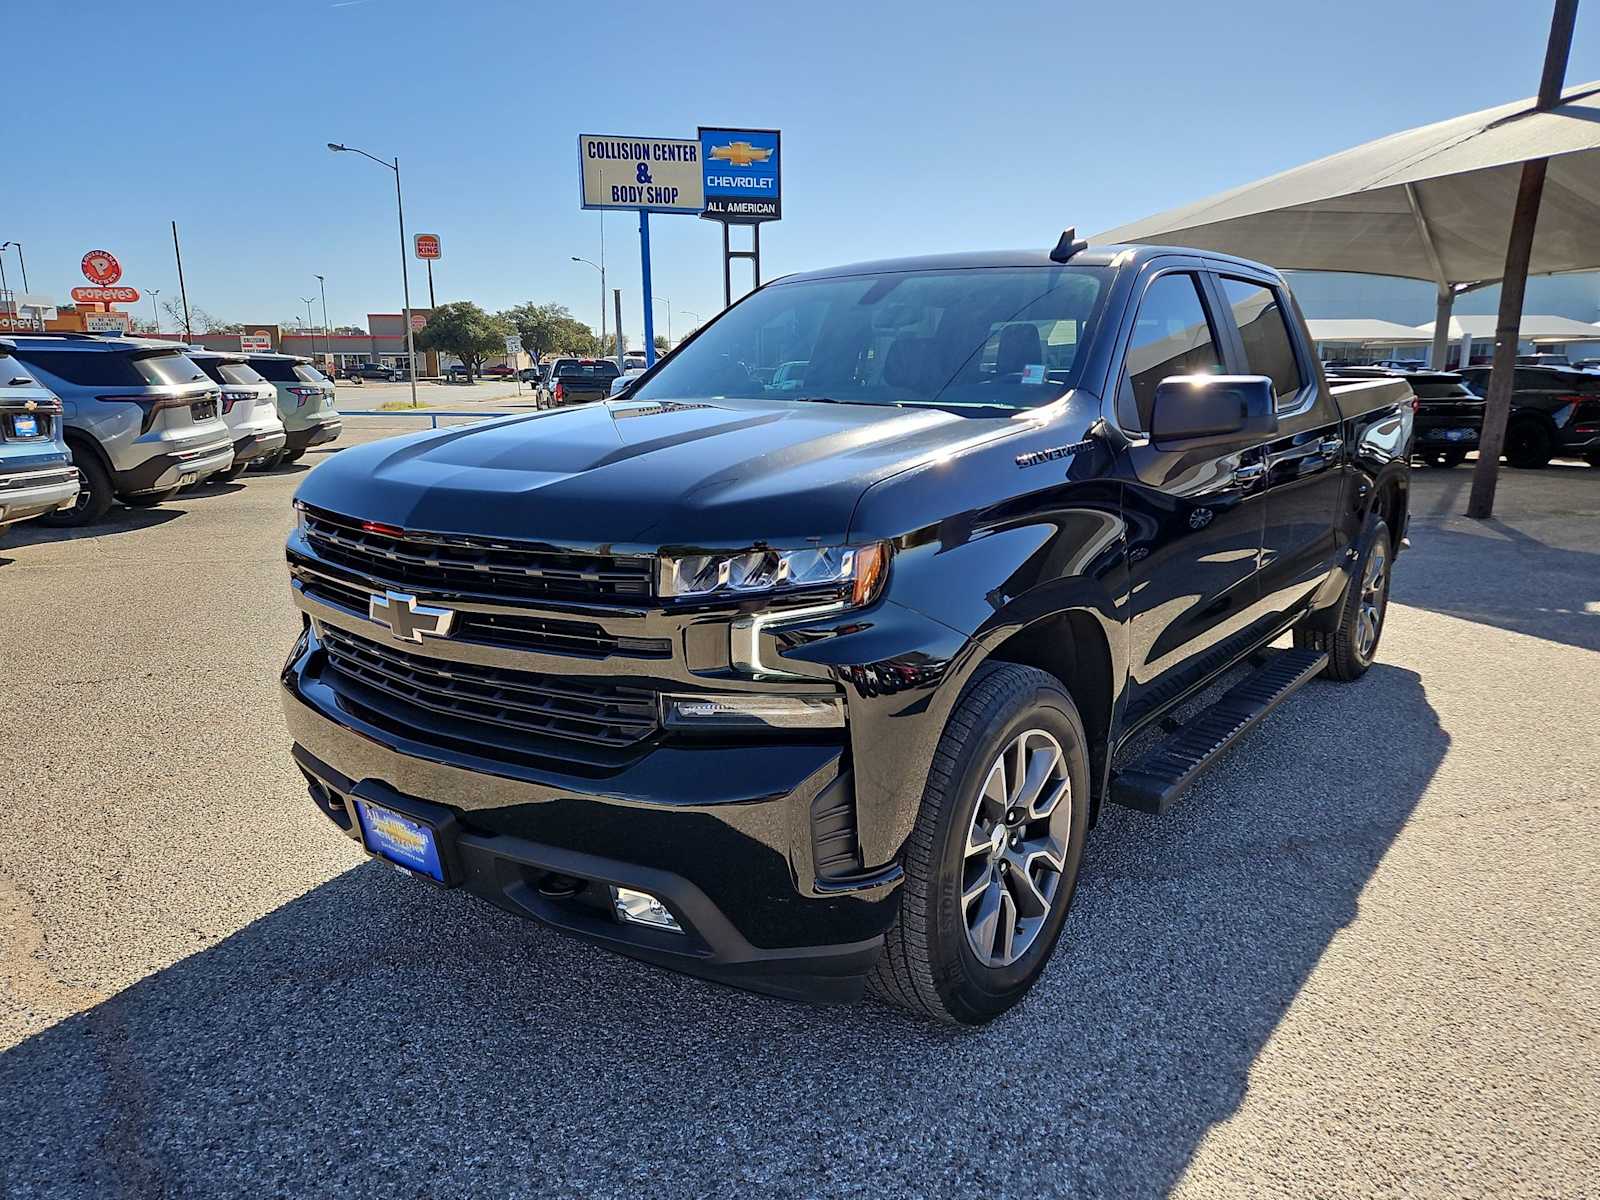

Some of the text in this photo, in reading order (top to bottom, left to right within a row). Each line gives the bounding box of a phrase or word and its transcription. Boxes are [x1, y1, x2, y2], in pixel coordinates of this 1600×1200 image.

[588, 141, 697, 162] COLLISION CENTER
[636, 162, 652, 184] &
[707, 175, 774, 188] CHEVROLET
[612, 185, 679, 204] BODY SHOP
[707, 201, 776, 214] ALL AMERICAN
[79, 289, 133, 300] POPEYES
[0, 318, 43, 330] OPEYE
[508, 344, 520, 352] 35
